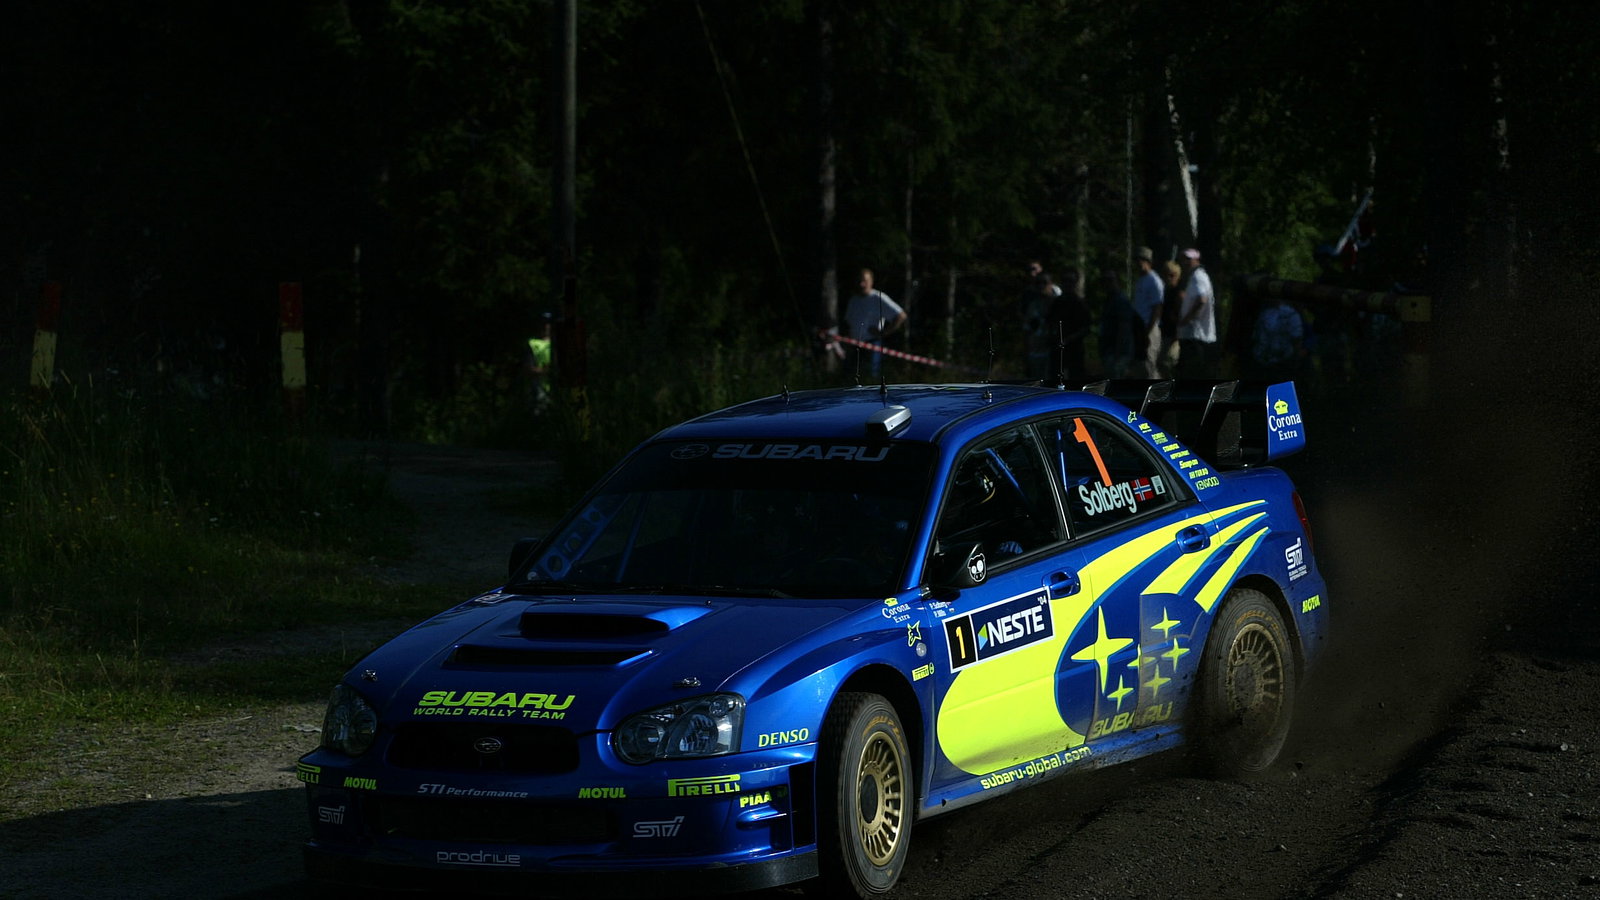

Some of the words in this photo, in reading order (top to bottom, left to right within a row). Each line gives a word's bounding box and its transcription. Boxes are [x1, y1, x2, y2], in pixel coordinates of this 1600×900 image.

[1269, 413, 1302, 432] Corona
[1278, 430, 1298, 441] Extra
[712, 443, 892, 462] SUBARU
[1073, 417, 1113, 487] 1
[1195, 476, 1220, 491] KENWOOD
[1078, 481, 1138, 516] Solberg
[882, 603, 911, 619] Corona
[893, 613, 911, 623] Extra
[987, 605, 1045, 647] NESTE
[956, 626, 966, 659] 1
[418, 690, 576, 710] SUBARU
[413, 707, 464, 716] WORLD
[468, 708, 516, 717] RALLY
[522, 710, 566, 720] TEAM
[758, 728, 809, 747] DENSO
[344, 776, 377, 790] MOTUL
[417, 783, 446, 794] STI
[446, 786, 529, 798] Performance
[667, 774, 741, 797] PIRELLI
[578, 787, 627, 799] MOTUL
[739, 790, 773, 808] PIAA
[436, 850, 521, 866] prodrive
